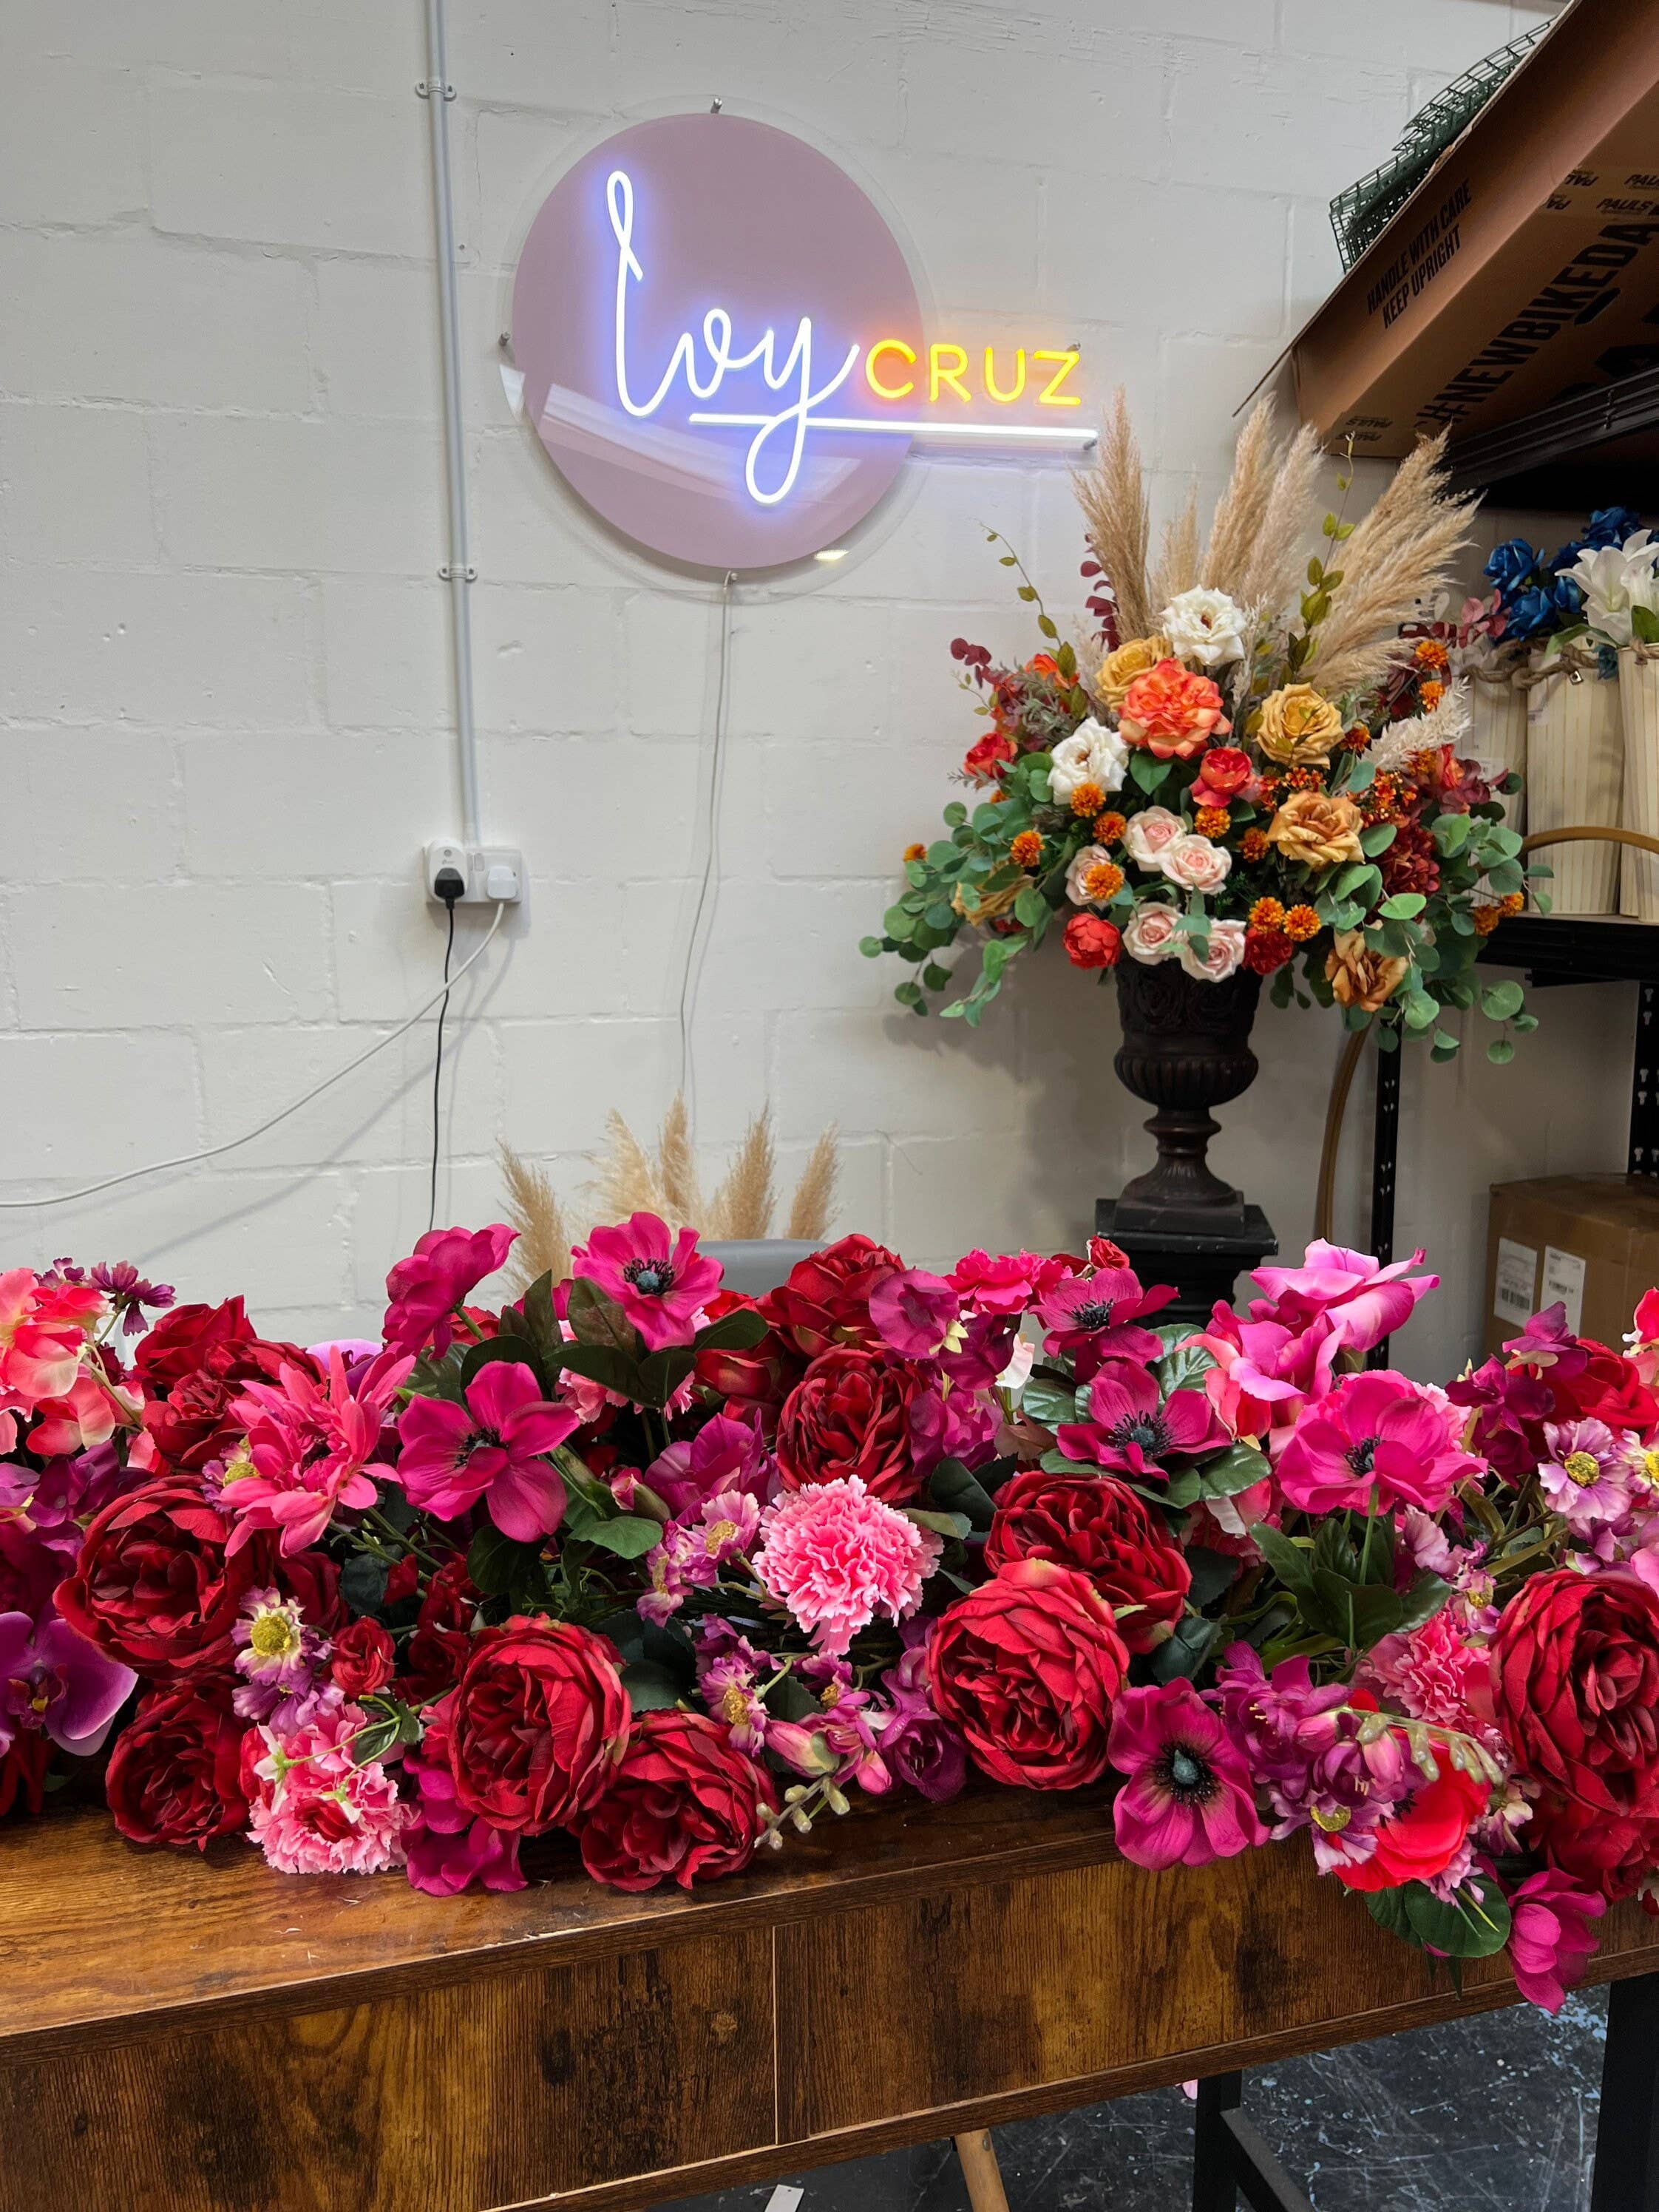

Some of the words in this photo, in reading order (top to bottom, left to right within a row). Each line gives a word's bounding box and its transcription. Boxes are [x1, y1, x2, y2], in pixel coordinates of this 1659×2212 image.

[1368, 248, 1410, 316] HANDLE
[1408, 213, 1440, 266] WITH
[1440, 177, 1472, 231] CARE
[1382, 283, 1410, 330] KEEP
[1411, 222, 1462, 296] UPRIGHT
[865, 339, 1082, 406] CRUZ
[1415, 206, 1659, 427] #NEWBIKEDA
